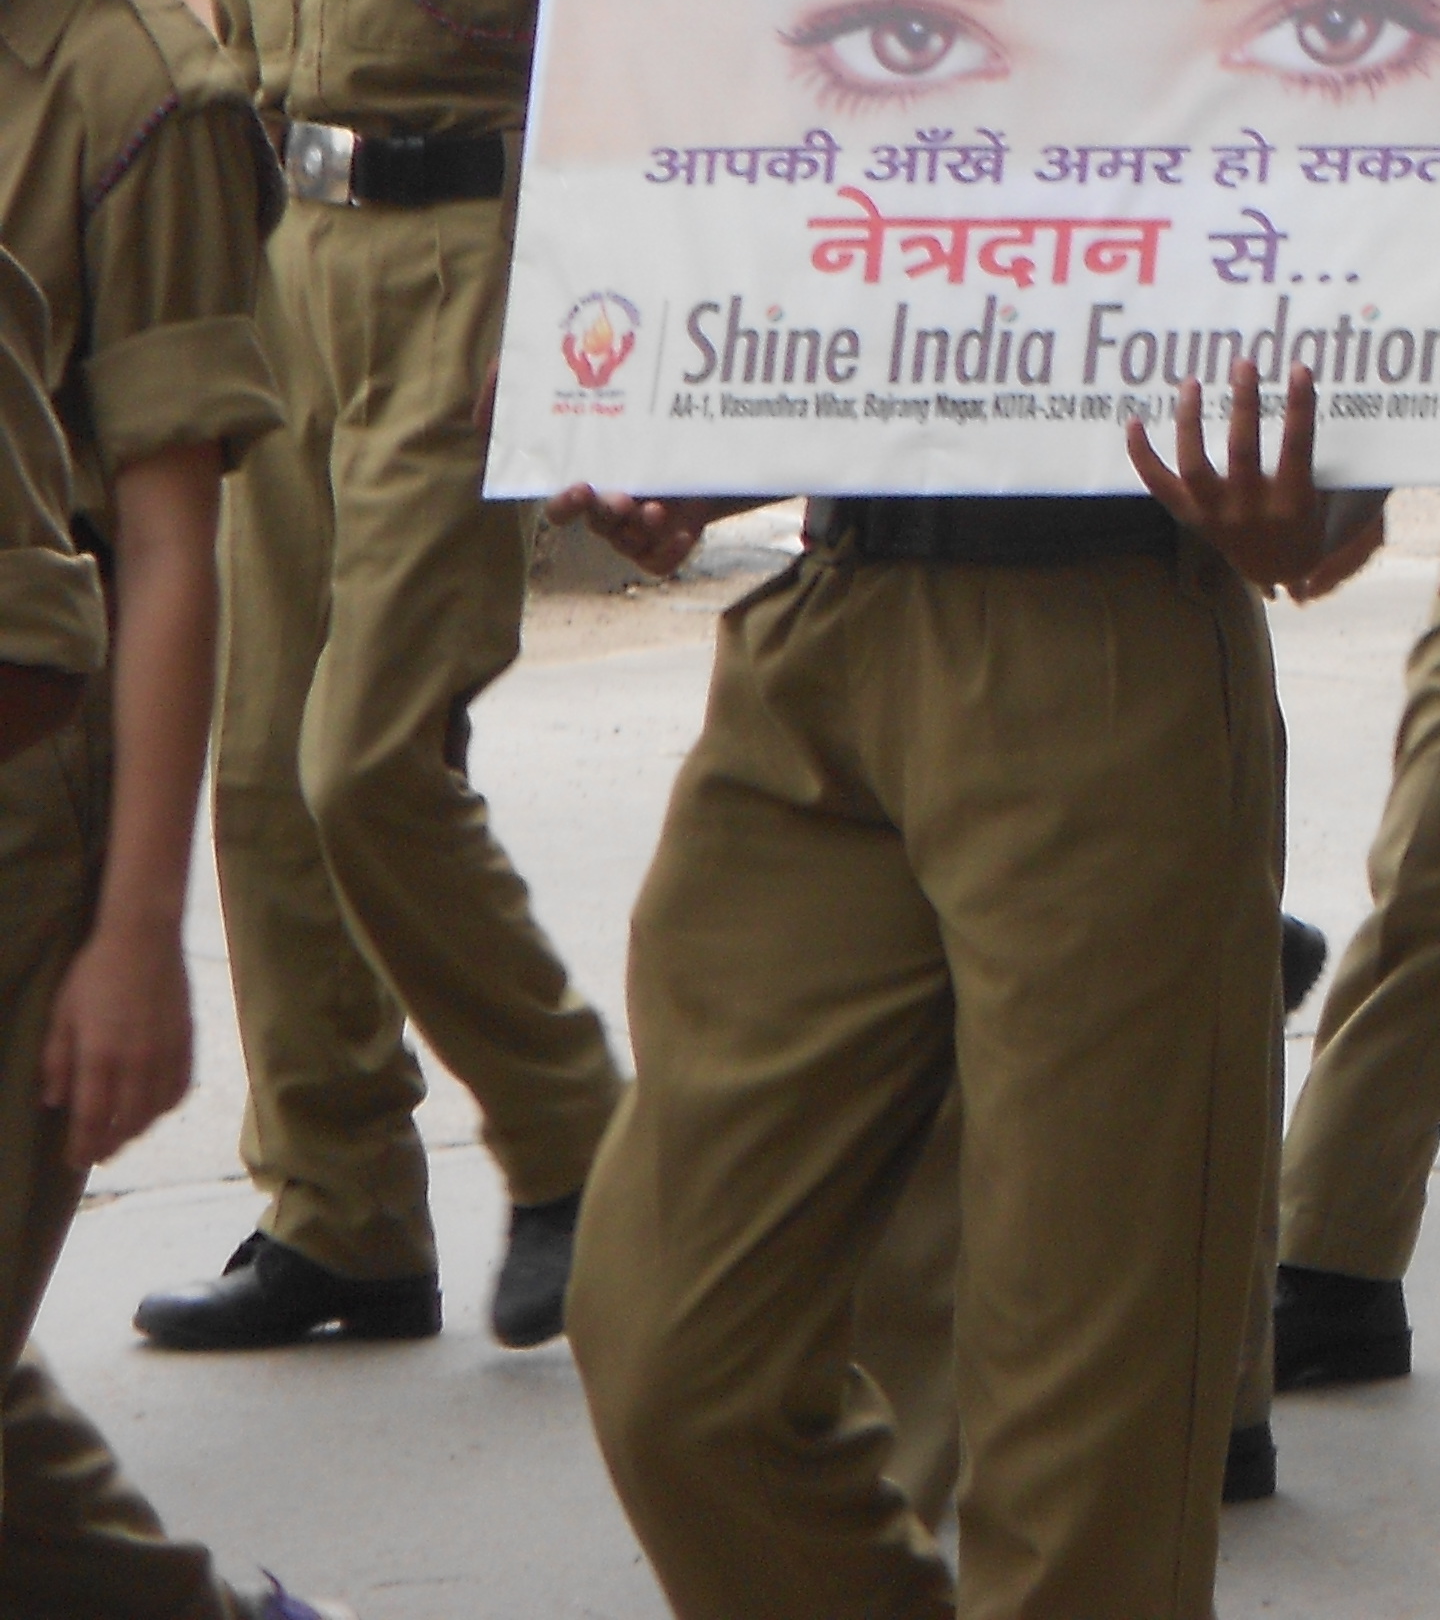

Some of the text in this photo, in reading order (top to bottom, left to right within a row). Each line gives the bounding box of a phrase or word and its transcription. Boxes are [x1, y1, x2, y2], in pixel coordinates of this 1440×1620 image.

[644, 128, 842, 186] आपकी
[865, 127, 1010, 185] आँखें
[1034, 143, 1191, 186] अमर
[1210, 127, 1278, 188] हो
[807, 184, 1172, 289] नेत्रदान
[681, 294, 862, 386] Shine
[886, 294, 1056, 386] India
